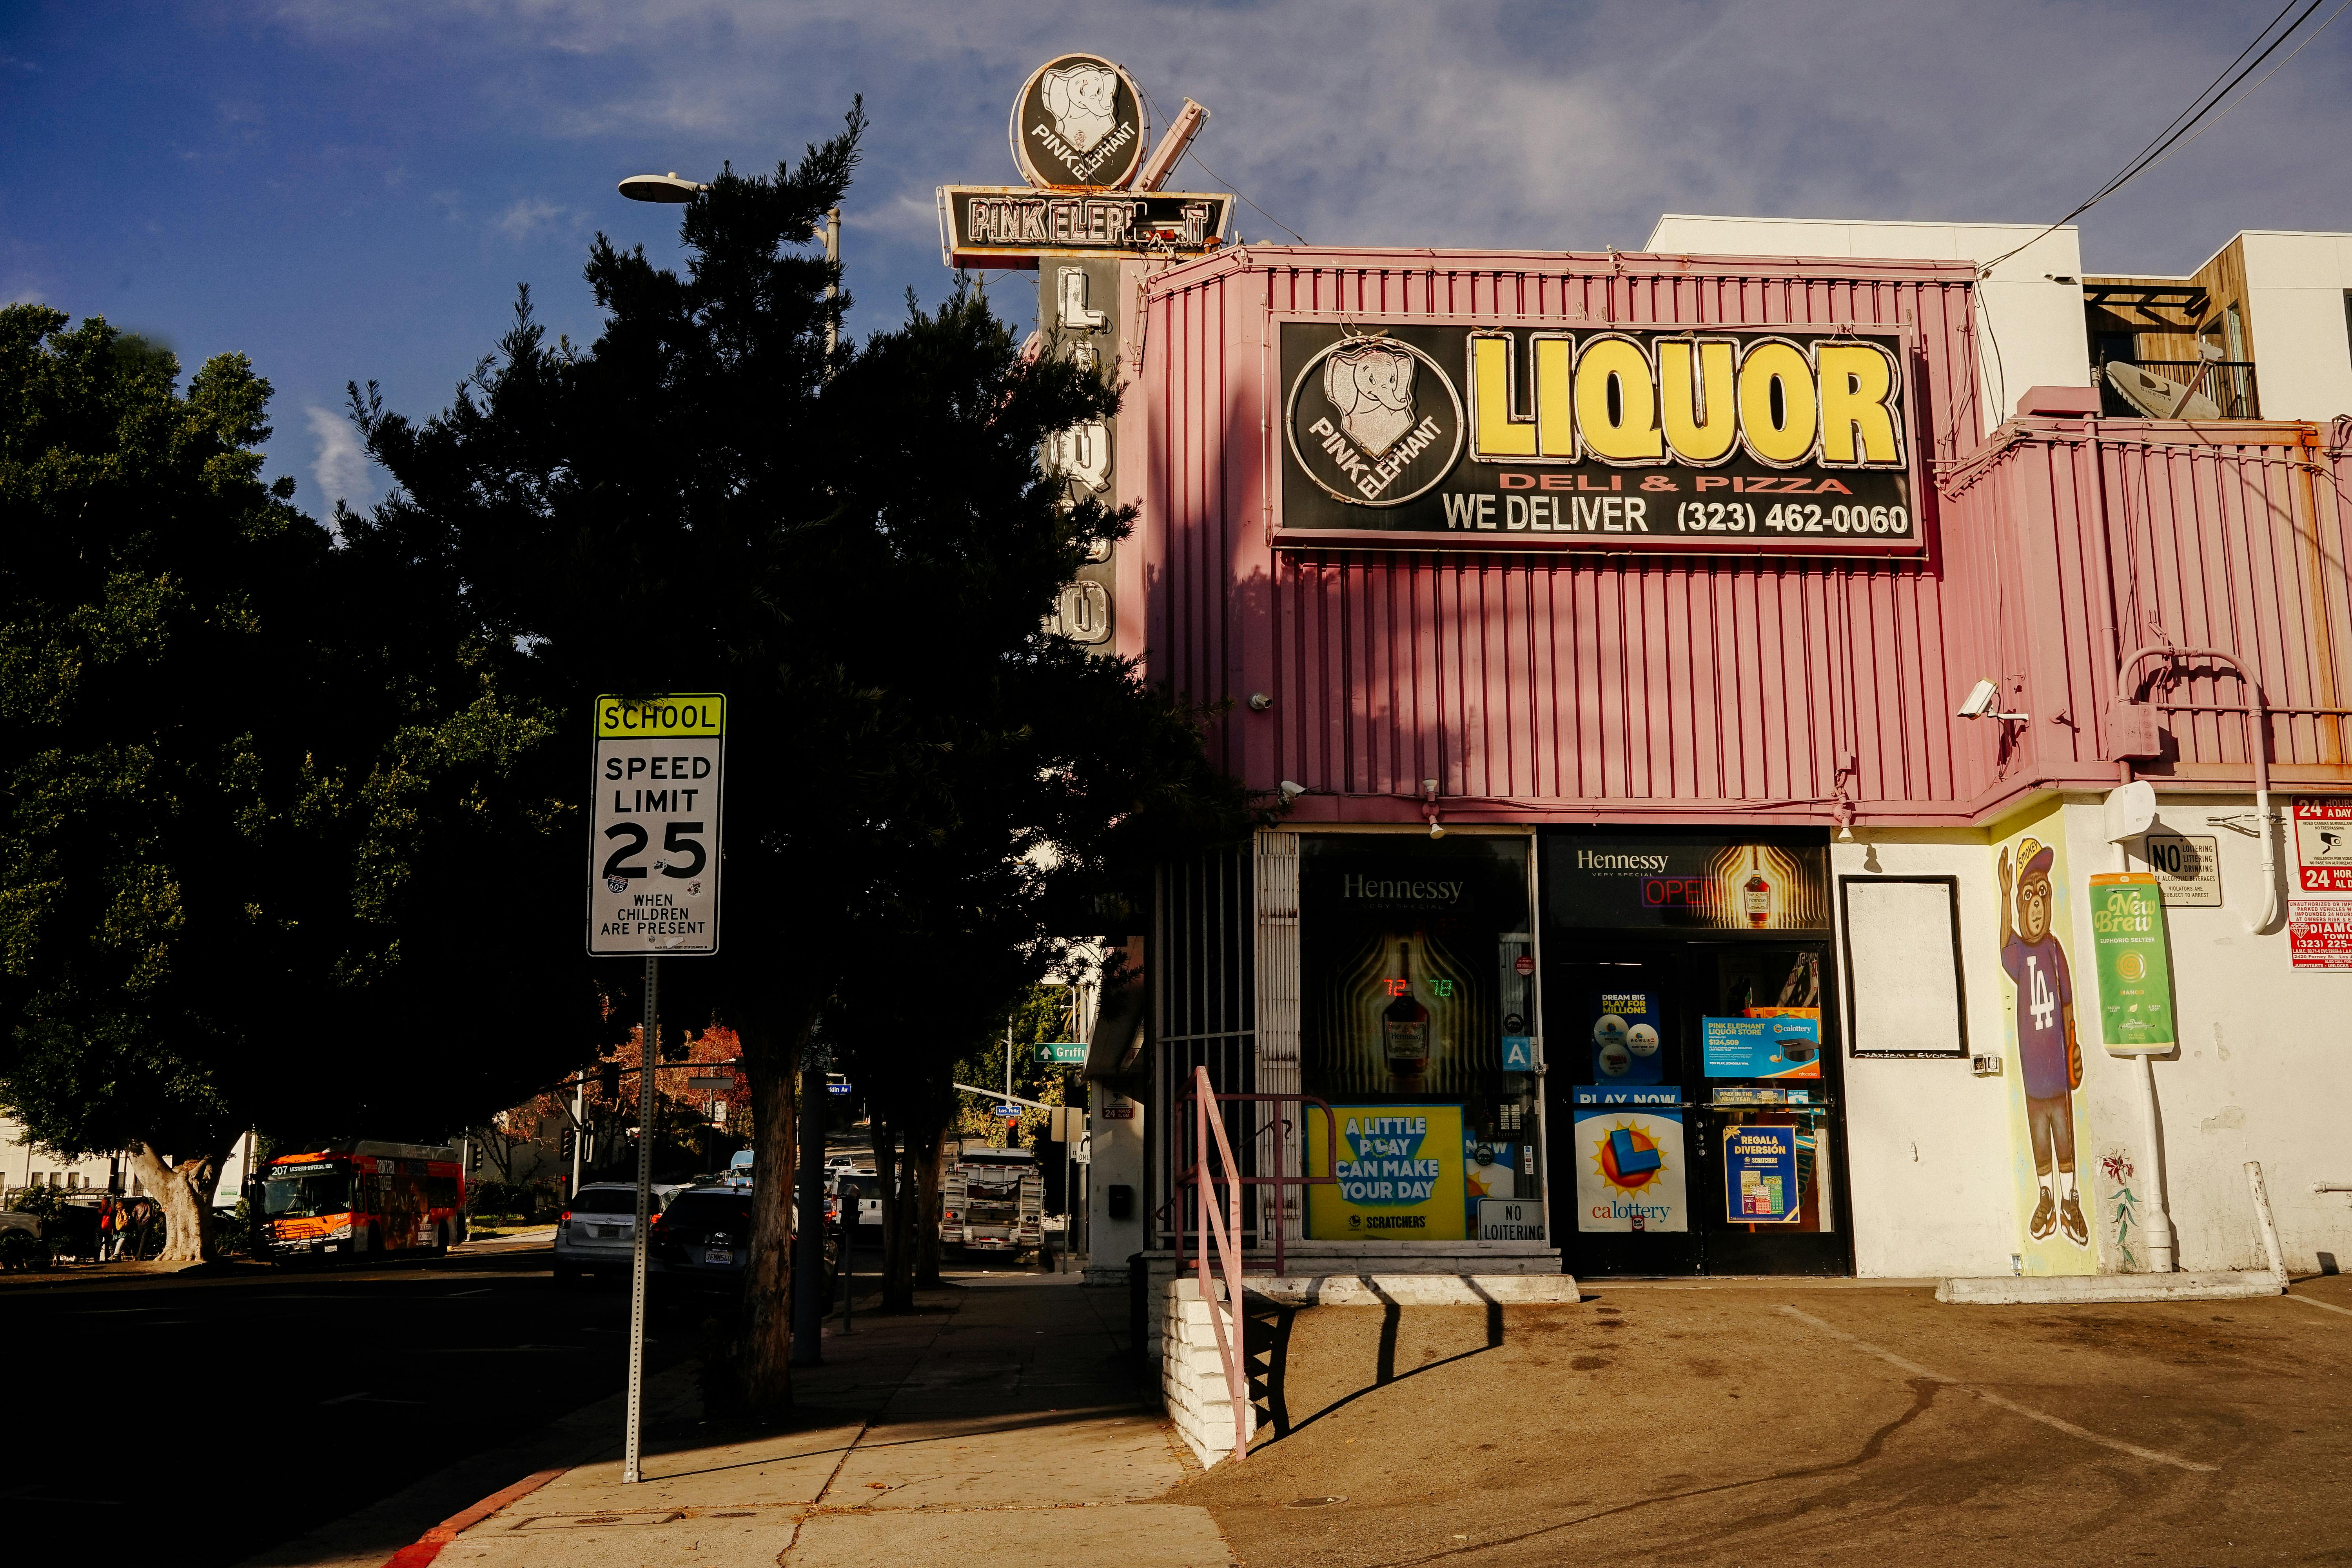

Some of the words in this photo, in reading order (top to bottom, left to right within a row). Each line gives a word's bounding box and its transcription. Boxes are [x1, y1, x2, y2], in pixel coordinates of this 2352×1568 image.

[1032, 123, 1079, 169] PINK
[1071, 121, 1136, 182] ELEPHANT
[971, 200, 1044, 240] PINK
[1471, 336, 1902, 465] LIQUOR
[2141, 387, 2171, 401] DIRECTV
[1309, 416, 1371, 483] PINK
[1357, 415, 1442, 500] ELEPHANT
[1500, 474, 1621, 491] DELI
[1640, 476, 1680, 492] &
[1696, 477, 1853, 495] PIZZA
[1443, 493, 1497, 530] WE
[1507, 495, 1648, 532] DELIVER
[1678, 502, 1755, 533] (323)
[1765, 503, 1909, 534] 462-0060
[604, 705, 716, 730] SCHOOL
[604, 756, 711, 781] SPEED
[615, 789, 698, 813] LIMIT
[2299, 800, 2322, 817] 24
[2335, 809, 2351, 817] DAY
[602, 822, 706, 879] 25
[2018, 841, 2038, 869] SMOKEY
[2152, 845, 2181, 873] NO
[1577, 850, 1669, 873] Hennessy
[609, 883, 624, 891] 605
[2306, 870, 2330, 887] 24
[2333, 869, 2352, 878] HOR
[2335, 880, 2346, 888] AL
[1343, 874, 1464, 904] Hennessy
[1647, 880, 1723, 904] OPEN
[634, 894, 673, 906] WHEN
[2107, 891, 2156, 915] New
[617, 908, 688, 920] CHILDREN
[2094, 911, 2152, 933] Brew
[601, 923, 630, 935] ARE
[637, 922, 705, 935] PRESENT
[1383, 979, 1406, 996] 72
[1429, 980, 1452, 996] 78
[2027, 956, 2054, 1030] LA
[1783, 1025, 1811, 1033] calottery
[1507, 1044, 1526, 1063] A
[1345, 1118, 1360, 1135] A
[1364, 1117, 1426, 1134] LITTLE
[1360, 1138, 1410, 1156] PLAY
[1466, 1140, 1507, 1154] NW
[1735, 1144, 1786, 1154] DIVERSIÓN
[1741, 1136, 1779, 1144] REGALA
[272, 1166, 288, 1176] 207
[1336, 1160, 1378, 1177] CAN
[1383, 1160, 1439, 1177] MAKE
[1338, 1181, 1393, 1199] YOUR
[1398, 1181, 1435, 1198] DAY
[1506, 1205, 1521, 1221] NO
[1592, 1201, 1670, 1223] calottery
[1367, 1216, 1426, 1229] SCRATCHERS
[1485, 1224, 1544, 1240] LOITERING
